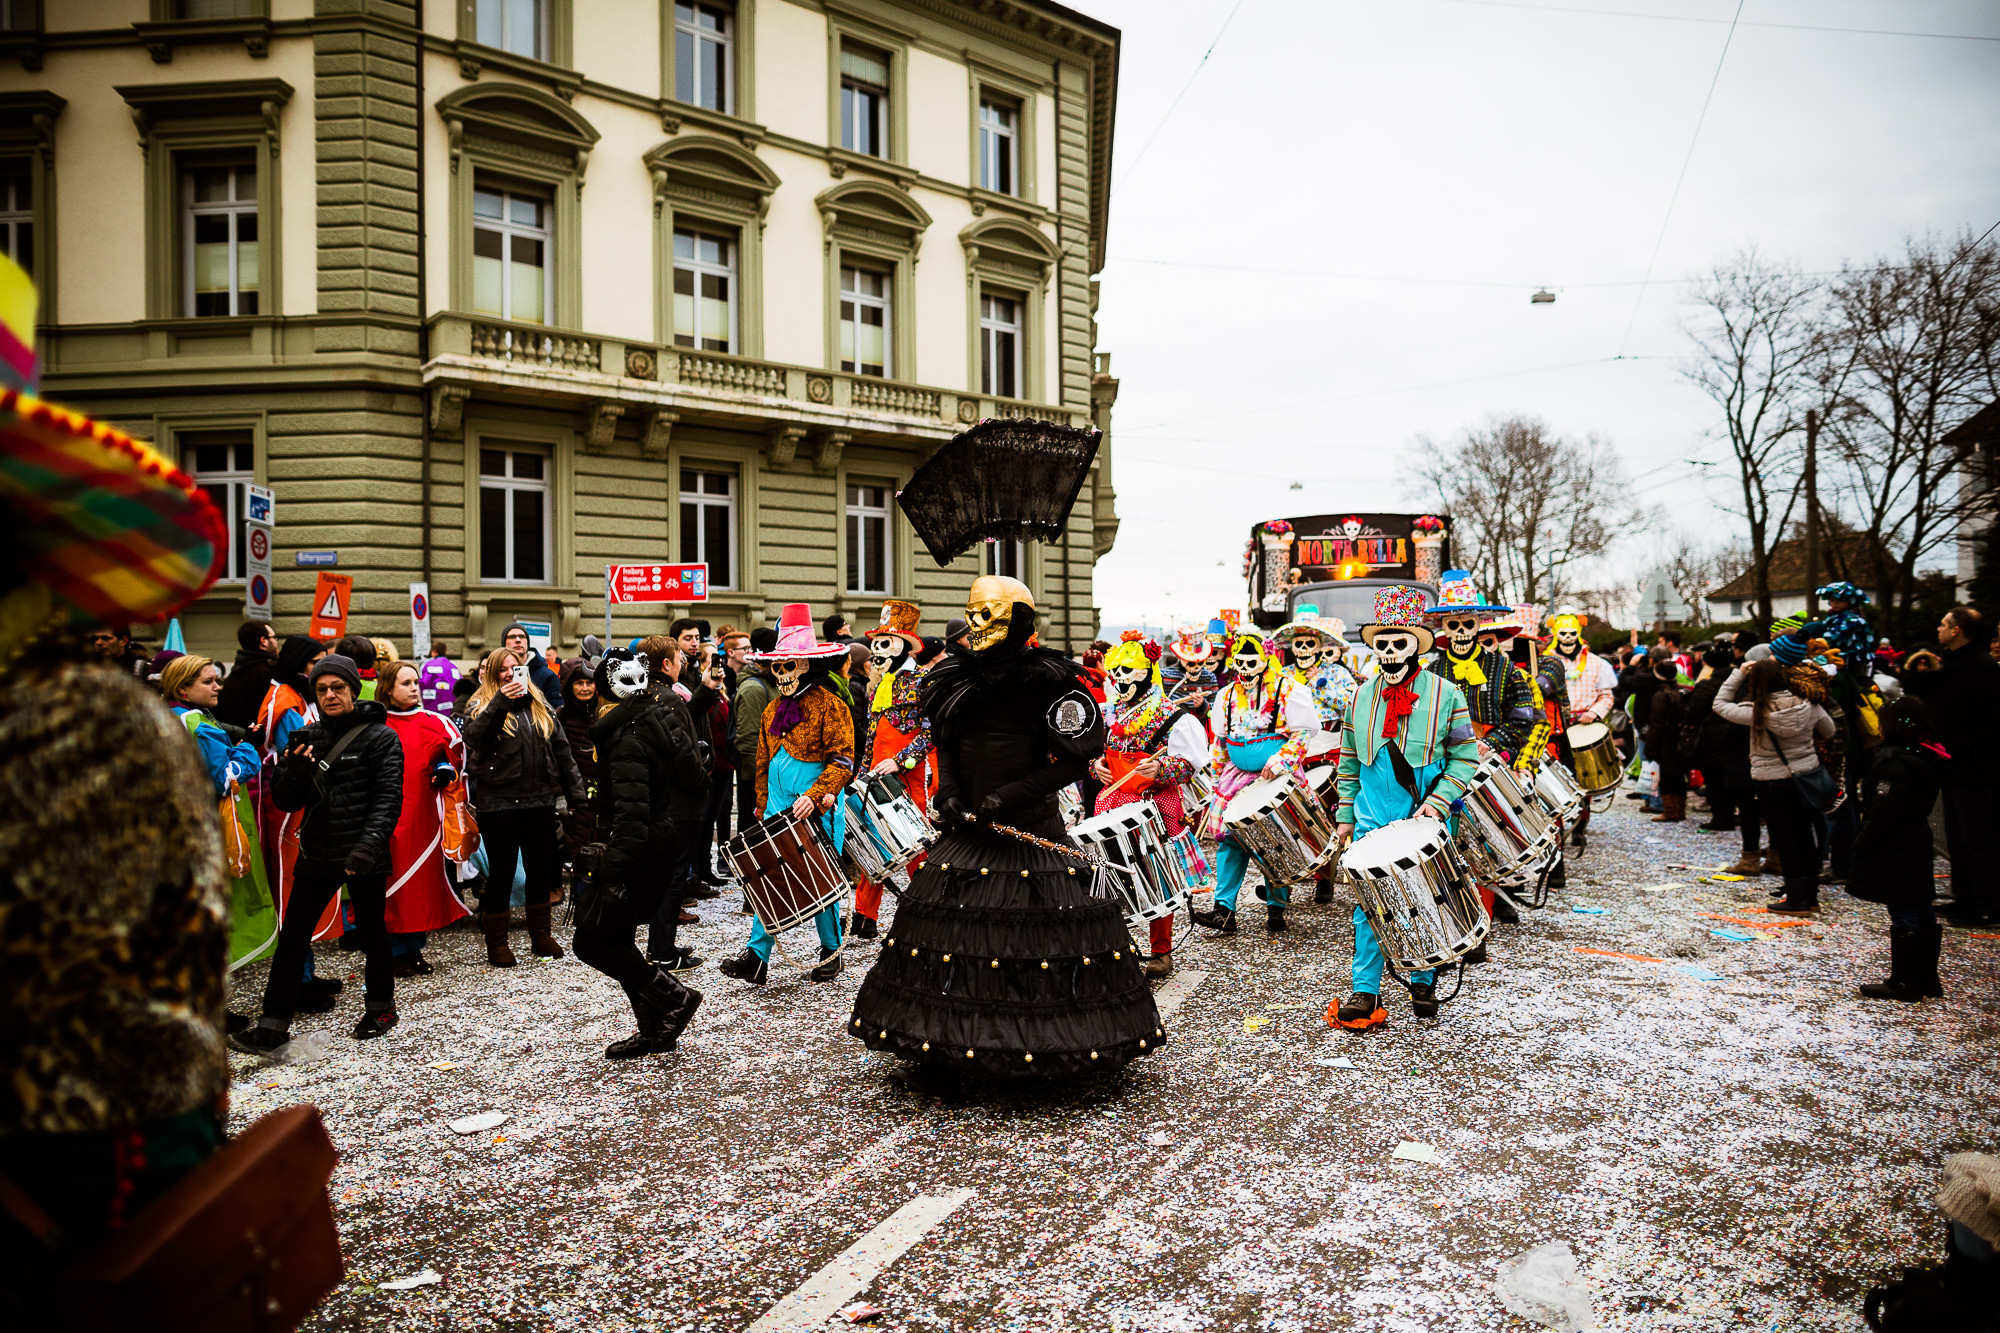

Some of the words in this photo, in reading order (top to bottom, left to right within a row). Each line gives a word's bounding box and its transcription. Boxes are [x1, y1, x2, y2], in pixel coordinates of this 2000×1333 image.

[1297, 539, 1353, 565] MORTA
[1357, 538, 1407, 564] BELLA
[695, 572, 704, 582] 2
[695, 583, 704, 594] 3
